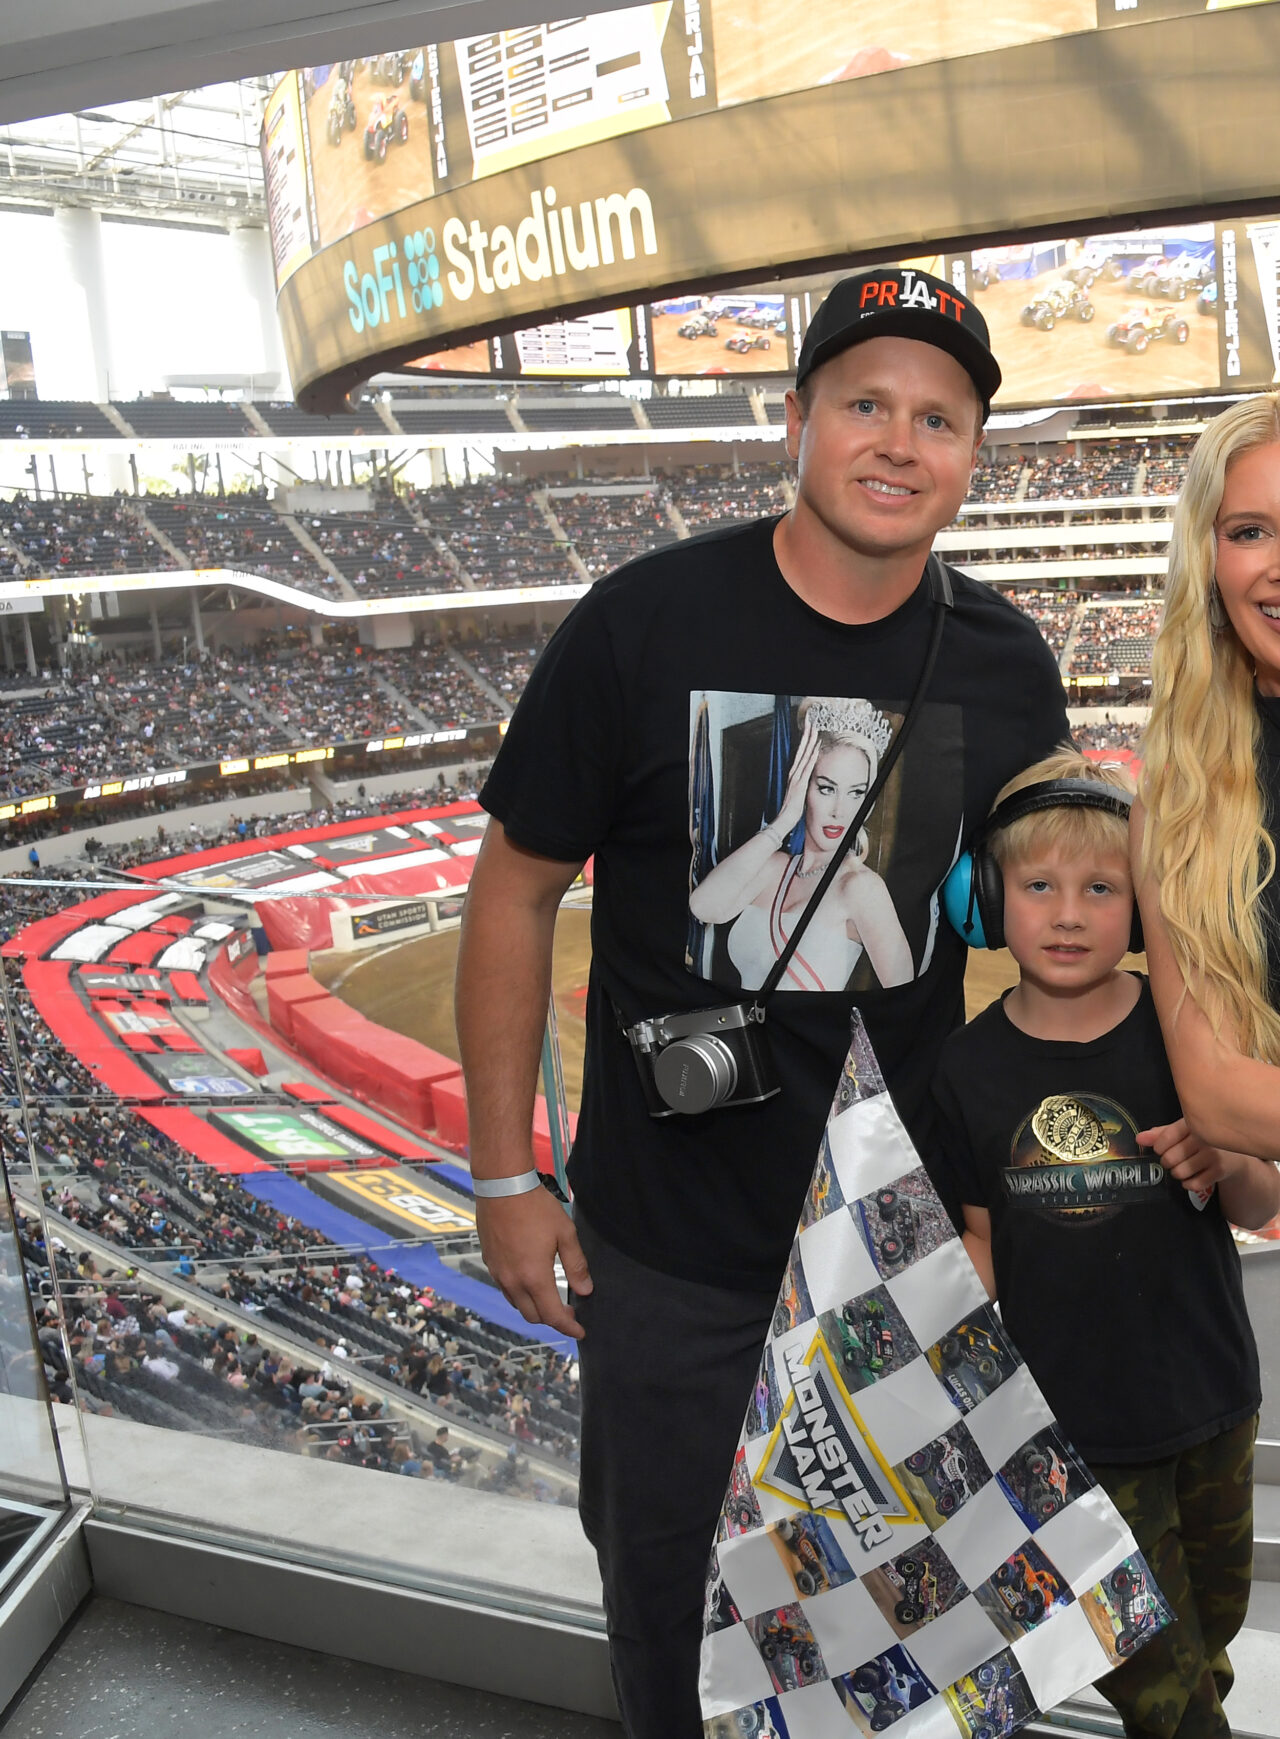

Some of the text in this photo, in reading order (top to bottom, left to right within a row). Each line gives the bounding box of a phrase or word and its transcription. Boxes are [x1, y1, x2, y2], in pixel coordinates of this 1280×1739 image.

[343, 186, 657, 333] SoFi Stadium
[378, 912, 427, 929] COMMISSION
[398, 904, 426, 917] SPORTS
[1004, 1163, 1164, 1195] JURASSIC WORLD
[388, 1194, 477, 1228] JCB
[947, 1373, 976, 1411] LUCAS OIL
[784, 1343, 895, 1552] MONSTER
[782, 1419, 837, 1511] JAM
[1001, 1586, 1018, 1606] JCB
